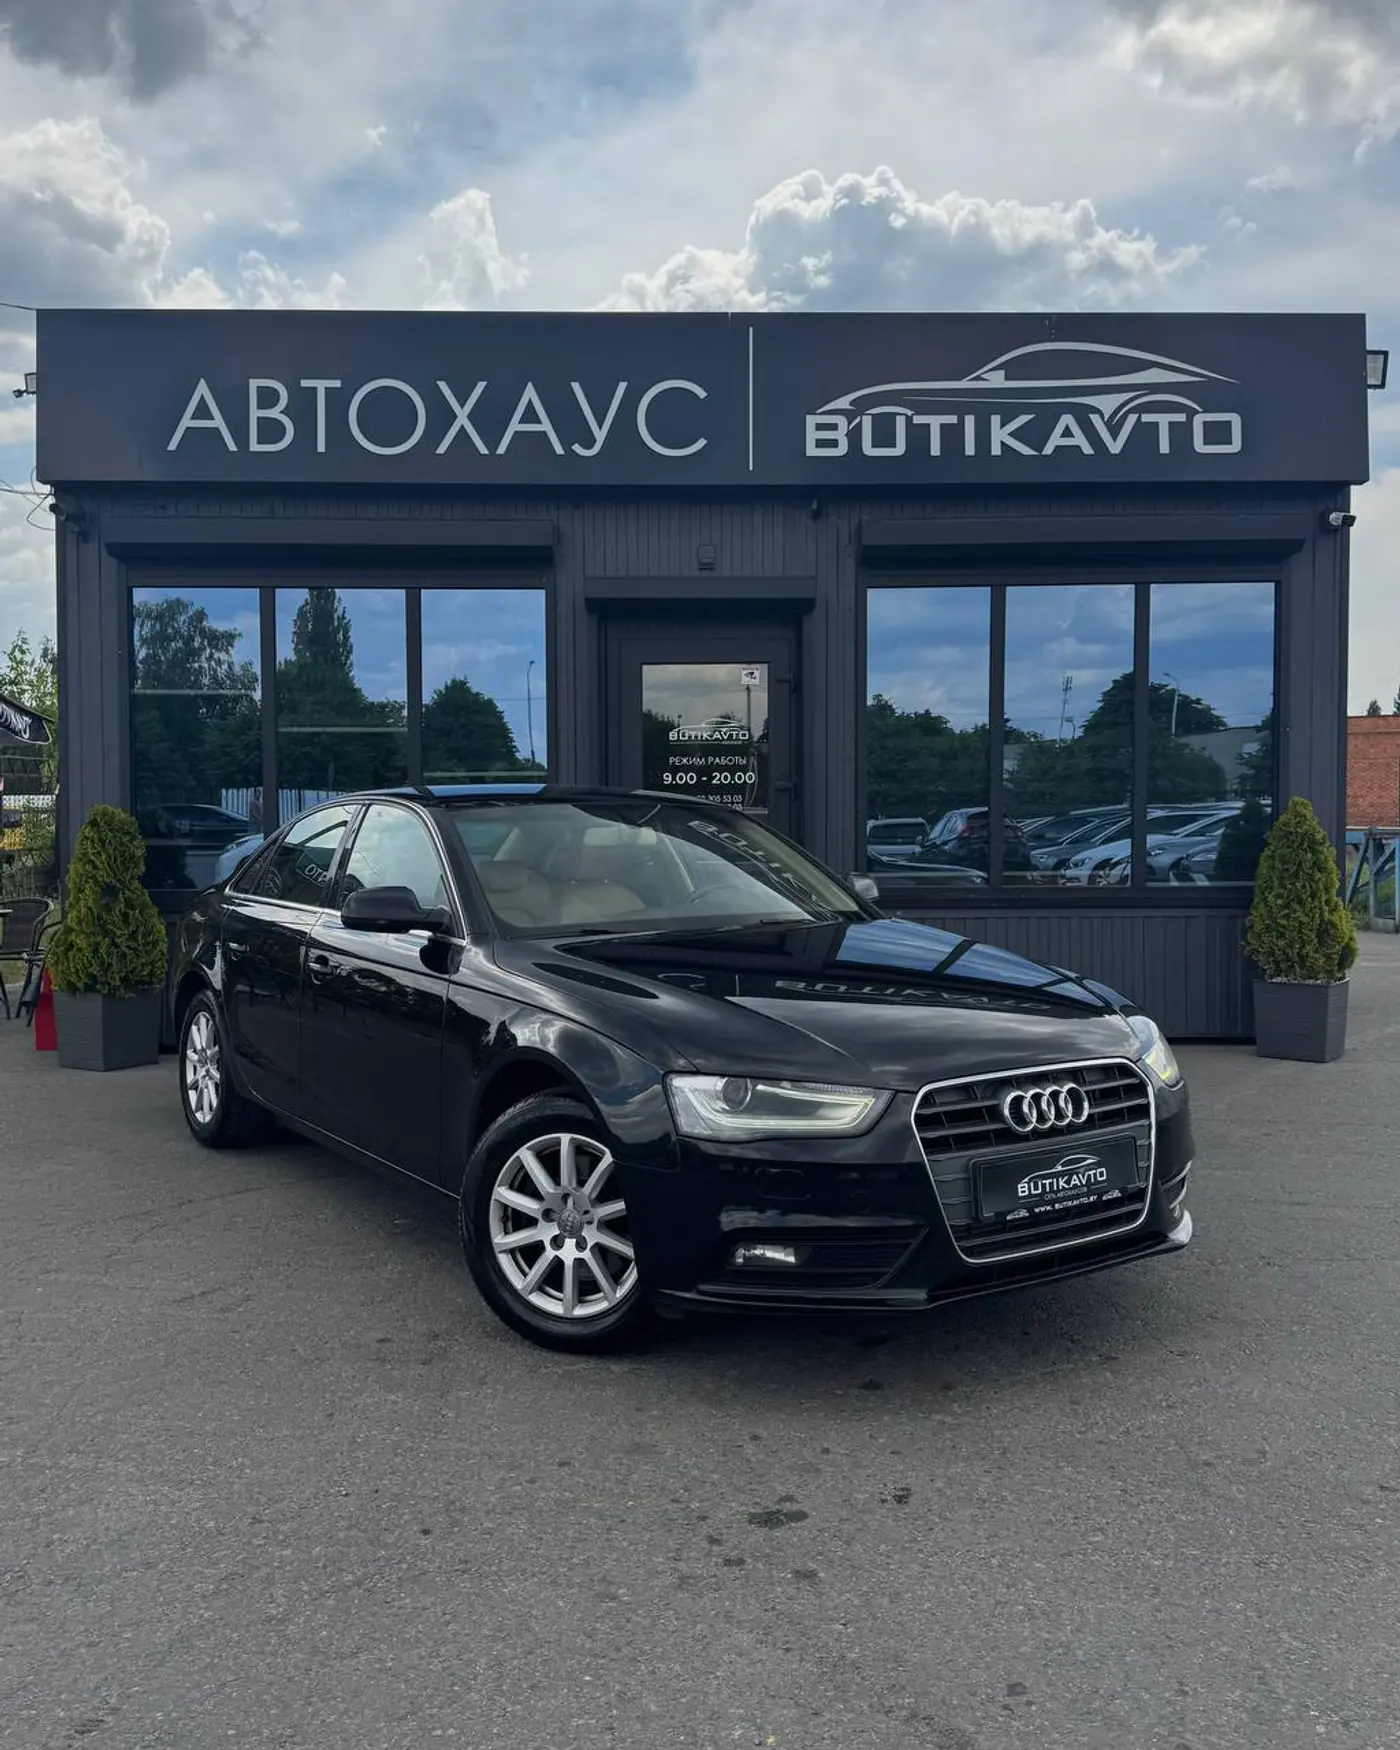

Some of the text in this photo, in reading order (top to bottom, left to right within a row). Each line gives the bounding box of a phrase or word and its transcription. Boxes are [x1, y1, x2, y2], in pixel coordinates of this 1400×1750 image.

[167, 377, 710, 458] АВТОХАУС
[805, 412, 1243, 458] BUTIKAVTO
[668, 731, 749, 741] BUTIKAVTO
[668, 756, 747, 766] РЕЖИМ РАБОТЫ
[663, 772, 697, 785] 9.00
[711, 772, 755, 785] 20.00
[1017, 1167, 1107, 1197] BUTIKAVTO
